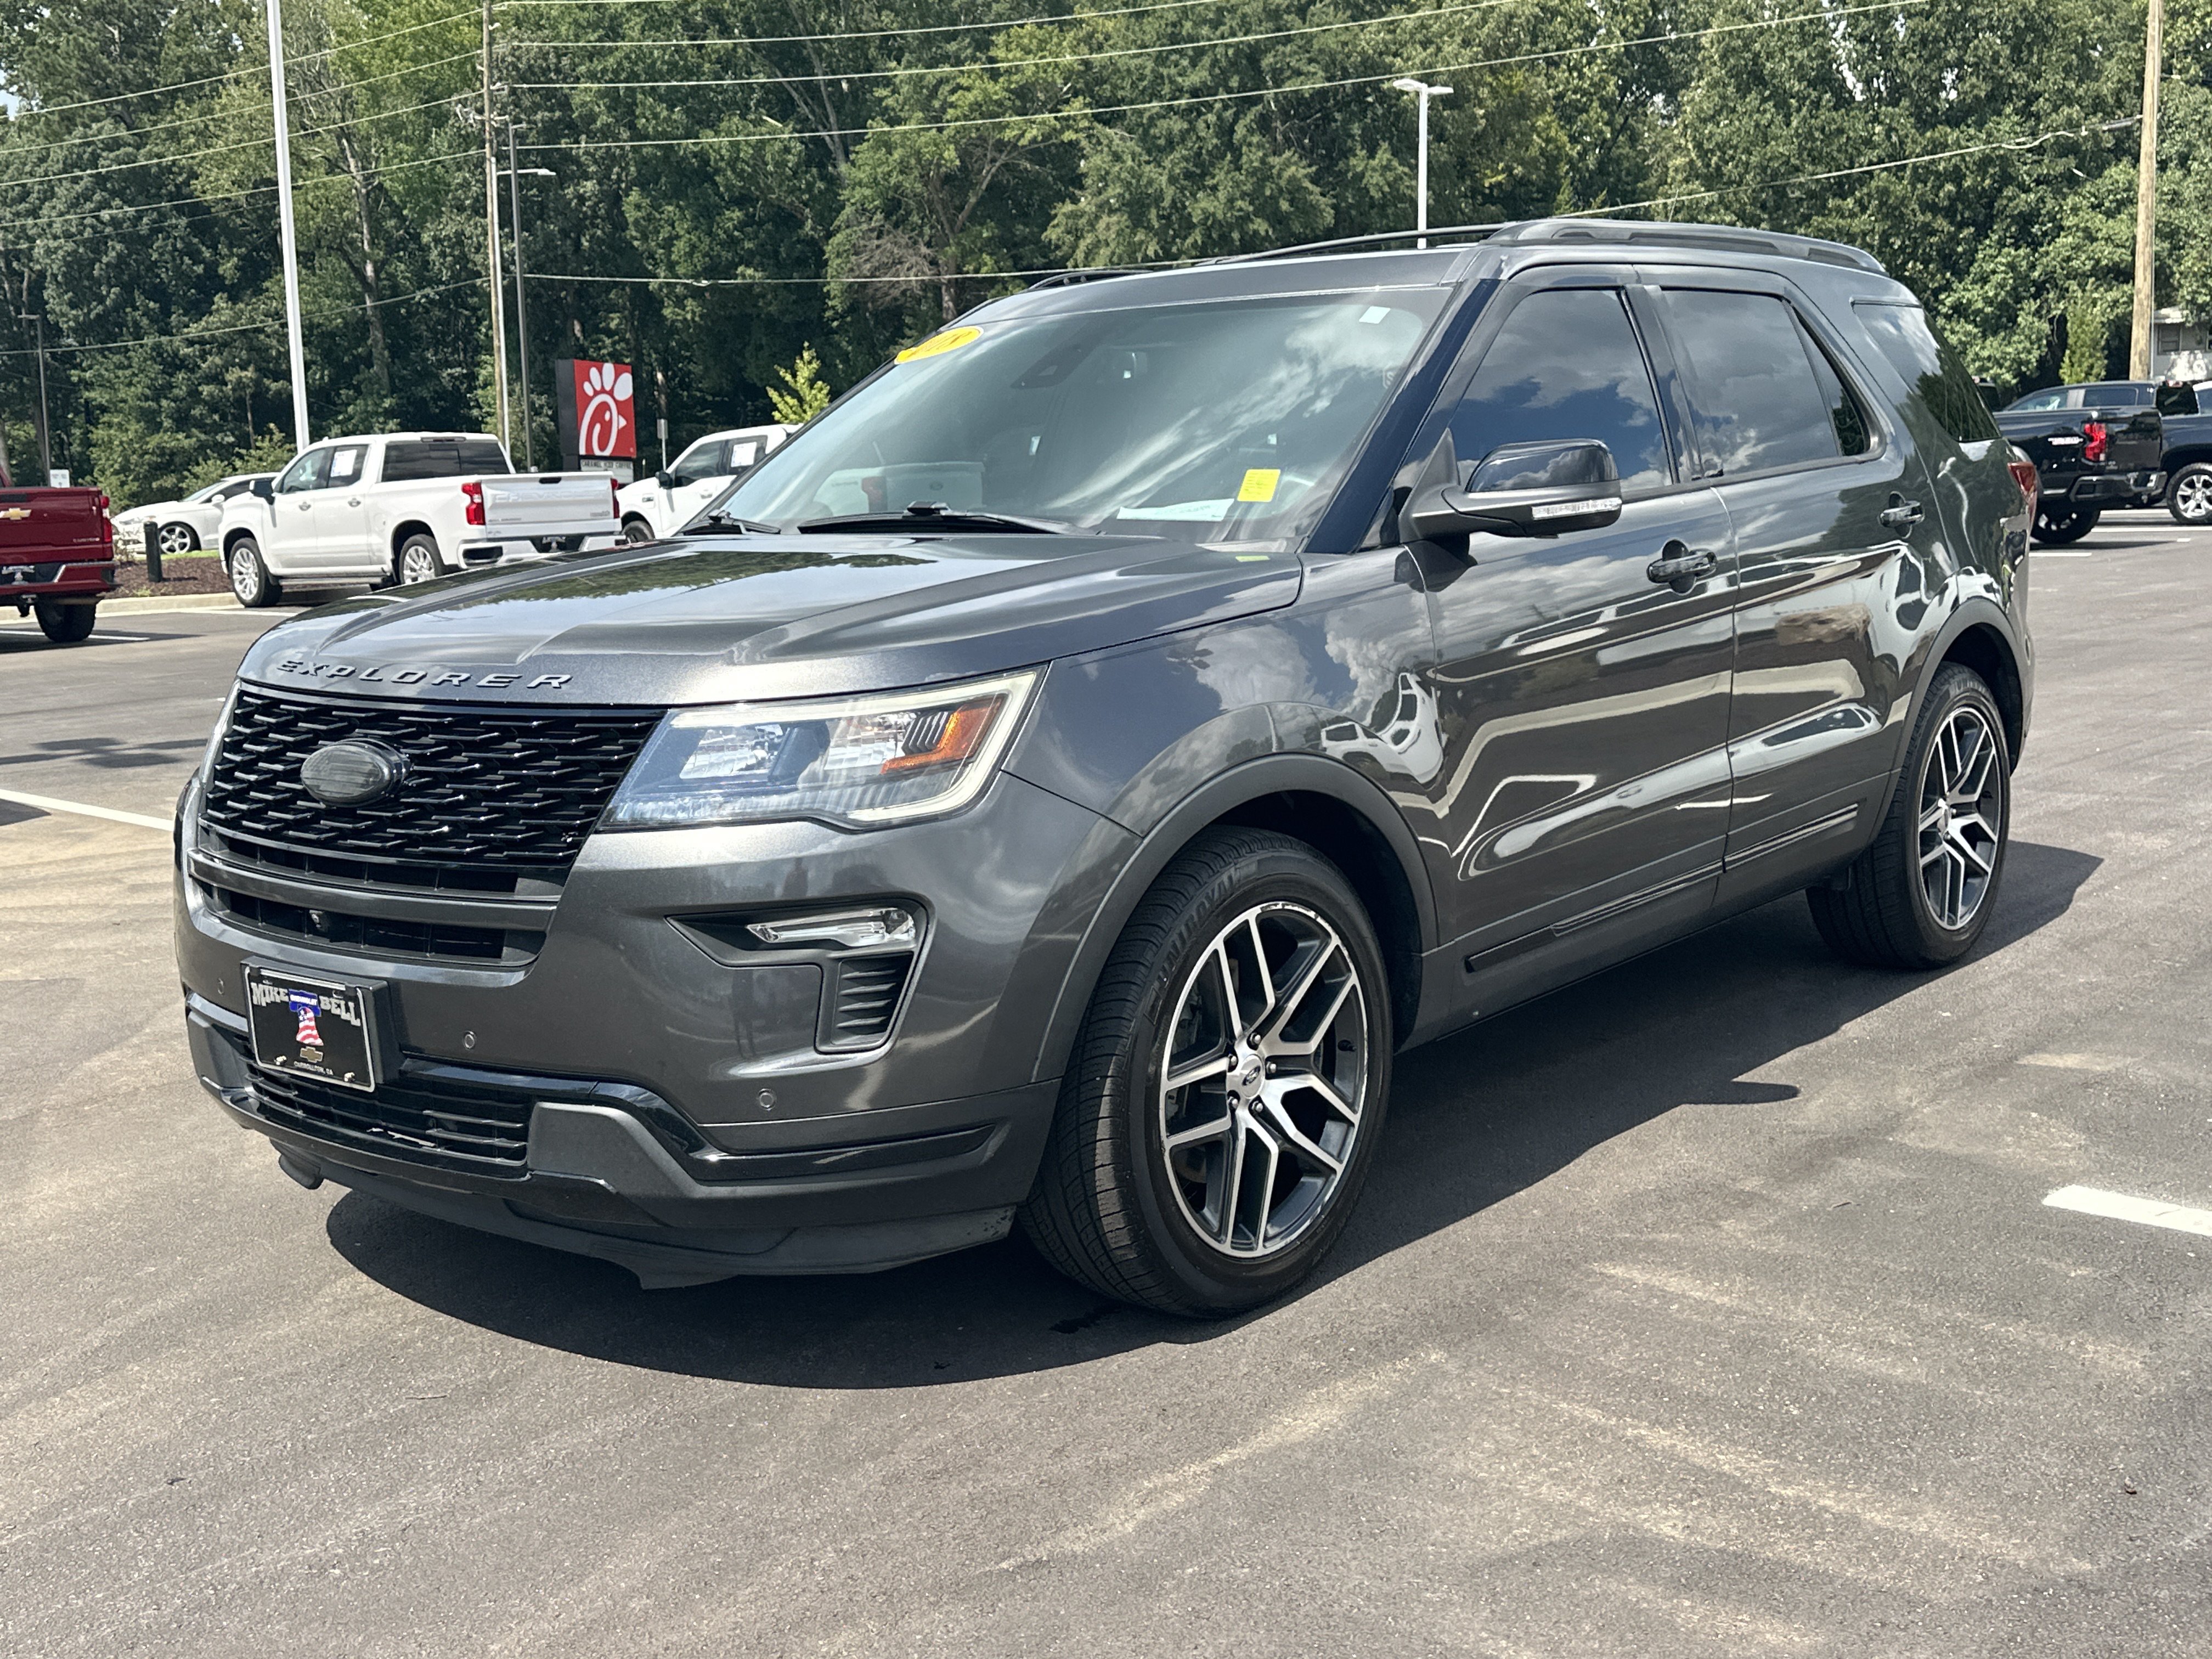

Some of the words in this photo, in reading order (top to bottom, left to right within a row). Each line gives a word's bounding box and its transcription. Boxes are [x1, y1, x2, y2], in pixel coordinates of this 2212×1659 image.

[276, 660, 572, 689] EXPLORER
[1155, 867, 1242, 988] UNIROYAL
[251, 982, 289, 1007] MIKE
[319, 996, 361, 1026] BELL
